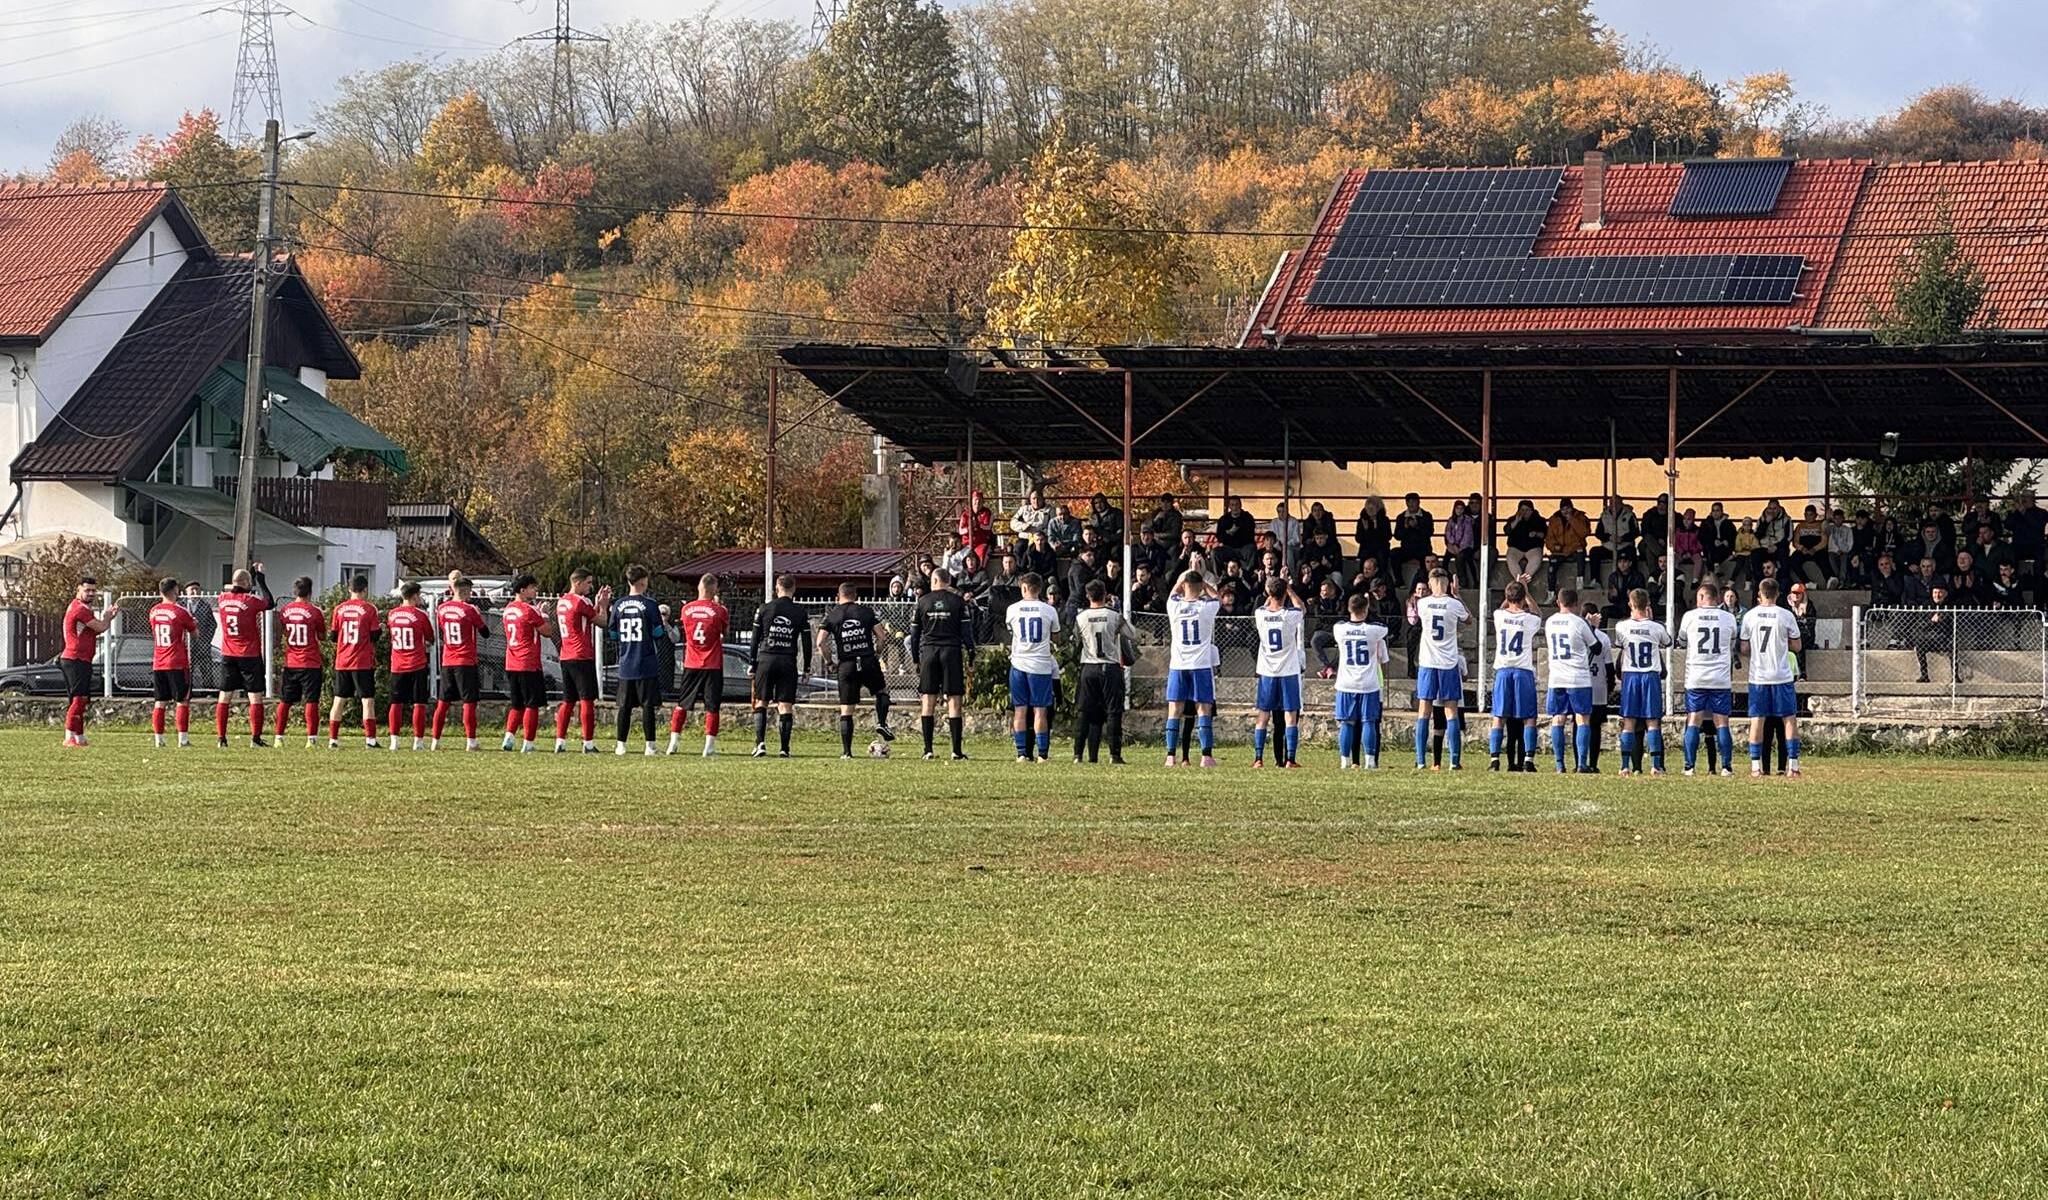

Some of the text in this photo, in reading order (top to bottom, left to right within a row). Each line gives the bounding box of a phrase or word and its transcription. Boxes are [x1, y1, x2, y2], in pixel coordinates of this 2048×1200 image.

[155, 624, 171, 647] 18
[227, 615, 238, 636] 3
[286, 624, 308, 646] 20
[342, 621, 359, 645] 15
[445, 622, 461, 645] 19
[507, 623, 517, 646] 2
[558, 615, 568, 638] 6
[620, 617, 643, 642] 93
[693, 621, 706, 644] 4
[769, 625, 794, 634] MOOV
[841, 627, 865, 638] MOOV
[1018, 617, 1042, 643] 10
[1180, 619, 1201, 646] 11
[1431, 615, 1445, 641] 5
[392, 627, 414, 650] 30
[1094, 631, 1106, 658] 1
[1268, 628, 1283, 652] 9
[1499, 629, 1524, 656] 14
[1551, 633, 1571, 660] 15
[1697, 627, 1720, 654] 21
[1759, 626, 1772, 653] 7
[1345, 640, 1369, 666] 16
[1628, 641, 1652, 668] 18
